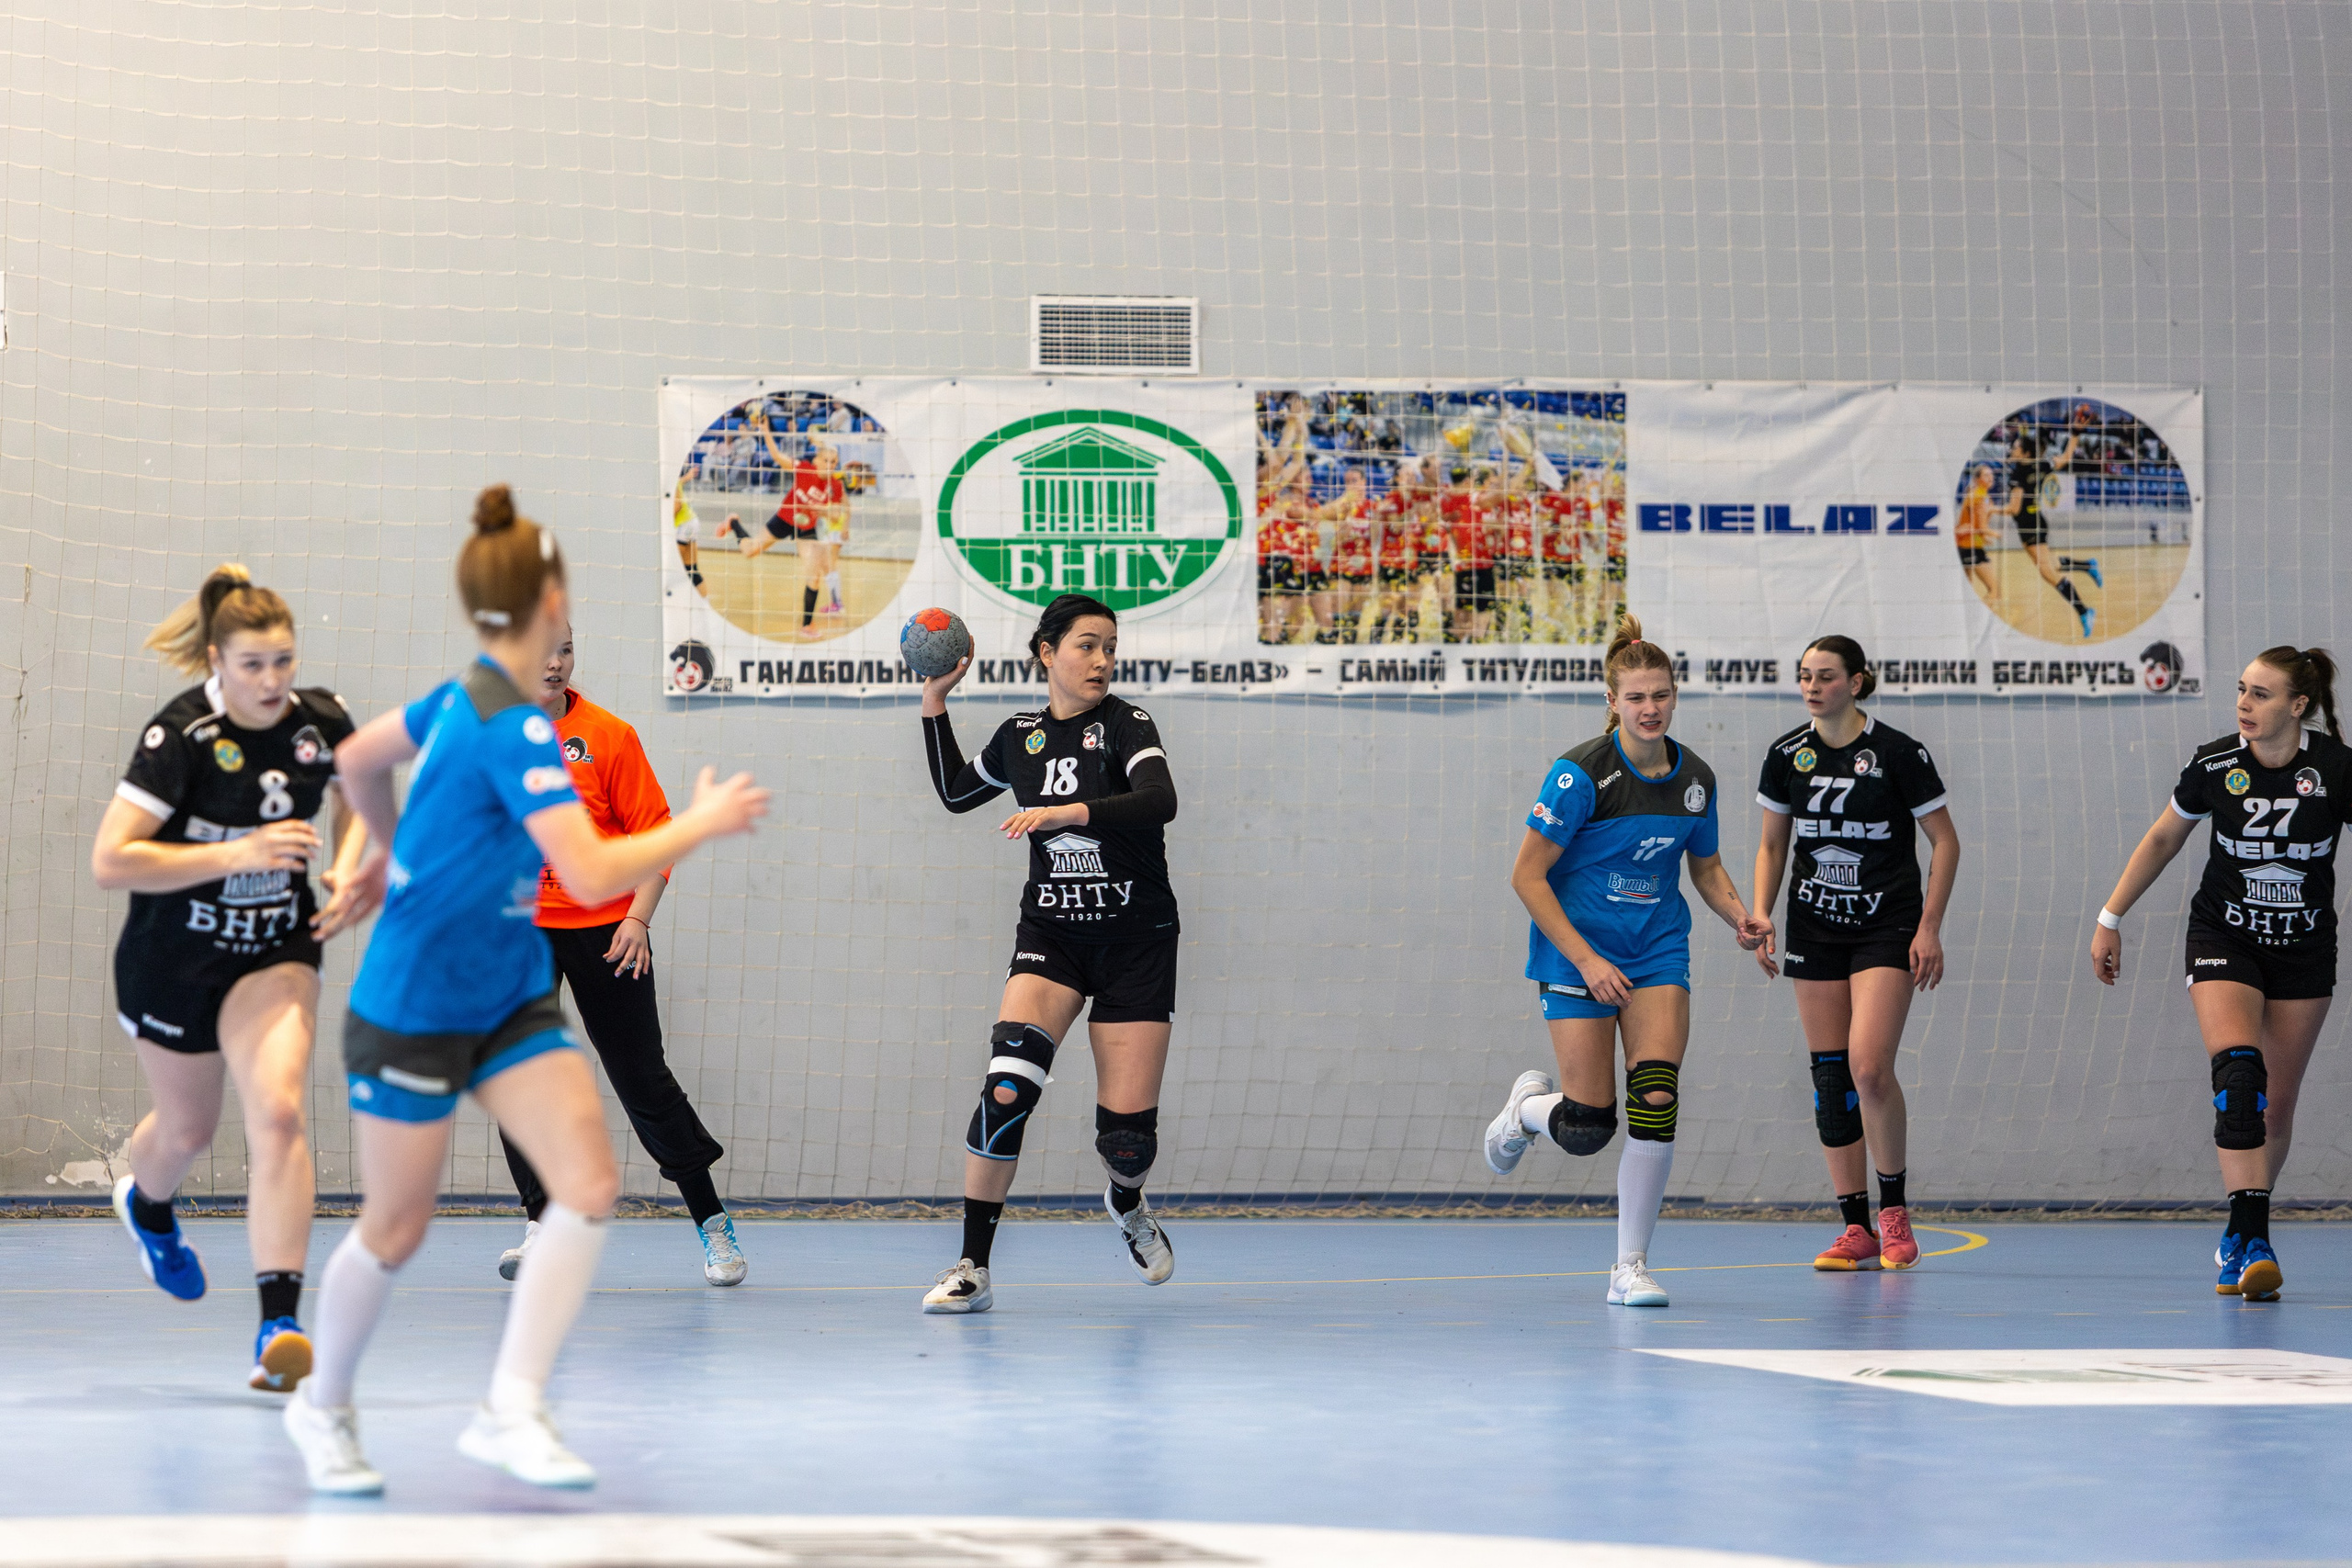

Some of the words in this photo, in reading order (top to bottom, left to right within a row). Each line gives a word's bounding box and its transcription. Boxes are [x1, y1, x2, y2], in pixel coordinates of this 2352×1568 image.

[1637, 503, 1939, 535] BELAZ
[1008, 544, 1188, 591] БНТУ
[978, 660, 1048, 683] КЛУ
[1340, 650, 1445, 682] САМЫЙ
[1705, 659, 1779, 683] КЛУБ
[1992, 660, 2135, 685] БЕЛАРУСЬ
[1040, 757, 1079, 795] 18
[2205, 757, 2239, 773] Kempa
[258, 769, 295, 820] 8
[1807, 775, 1856, 815] 77
[1793, 817, 1892, 840] ELAZ
[2242, 797, 2300, 837] 27
[1633, 837, 1675, 862] 17
[1037, 881, 1133, 908] БНТУ
[1797, 878, 1884, 916] БНТУ
[1070, 912, 1102, 921] 1920
[2224, 900, 2322, 934] БНТУ
[2257, 936, 2289, 945] 1920
[1016, 951, 1046, 963] Kempa
[2195, 957, 2227, 967] Kempa
